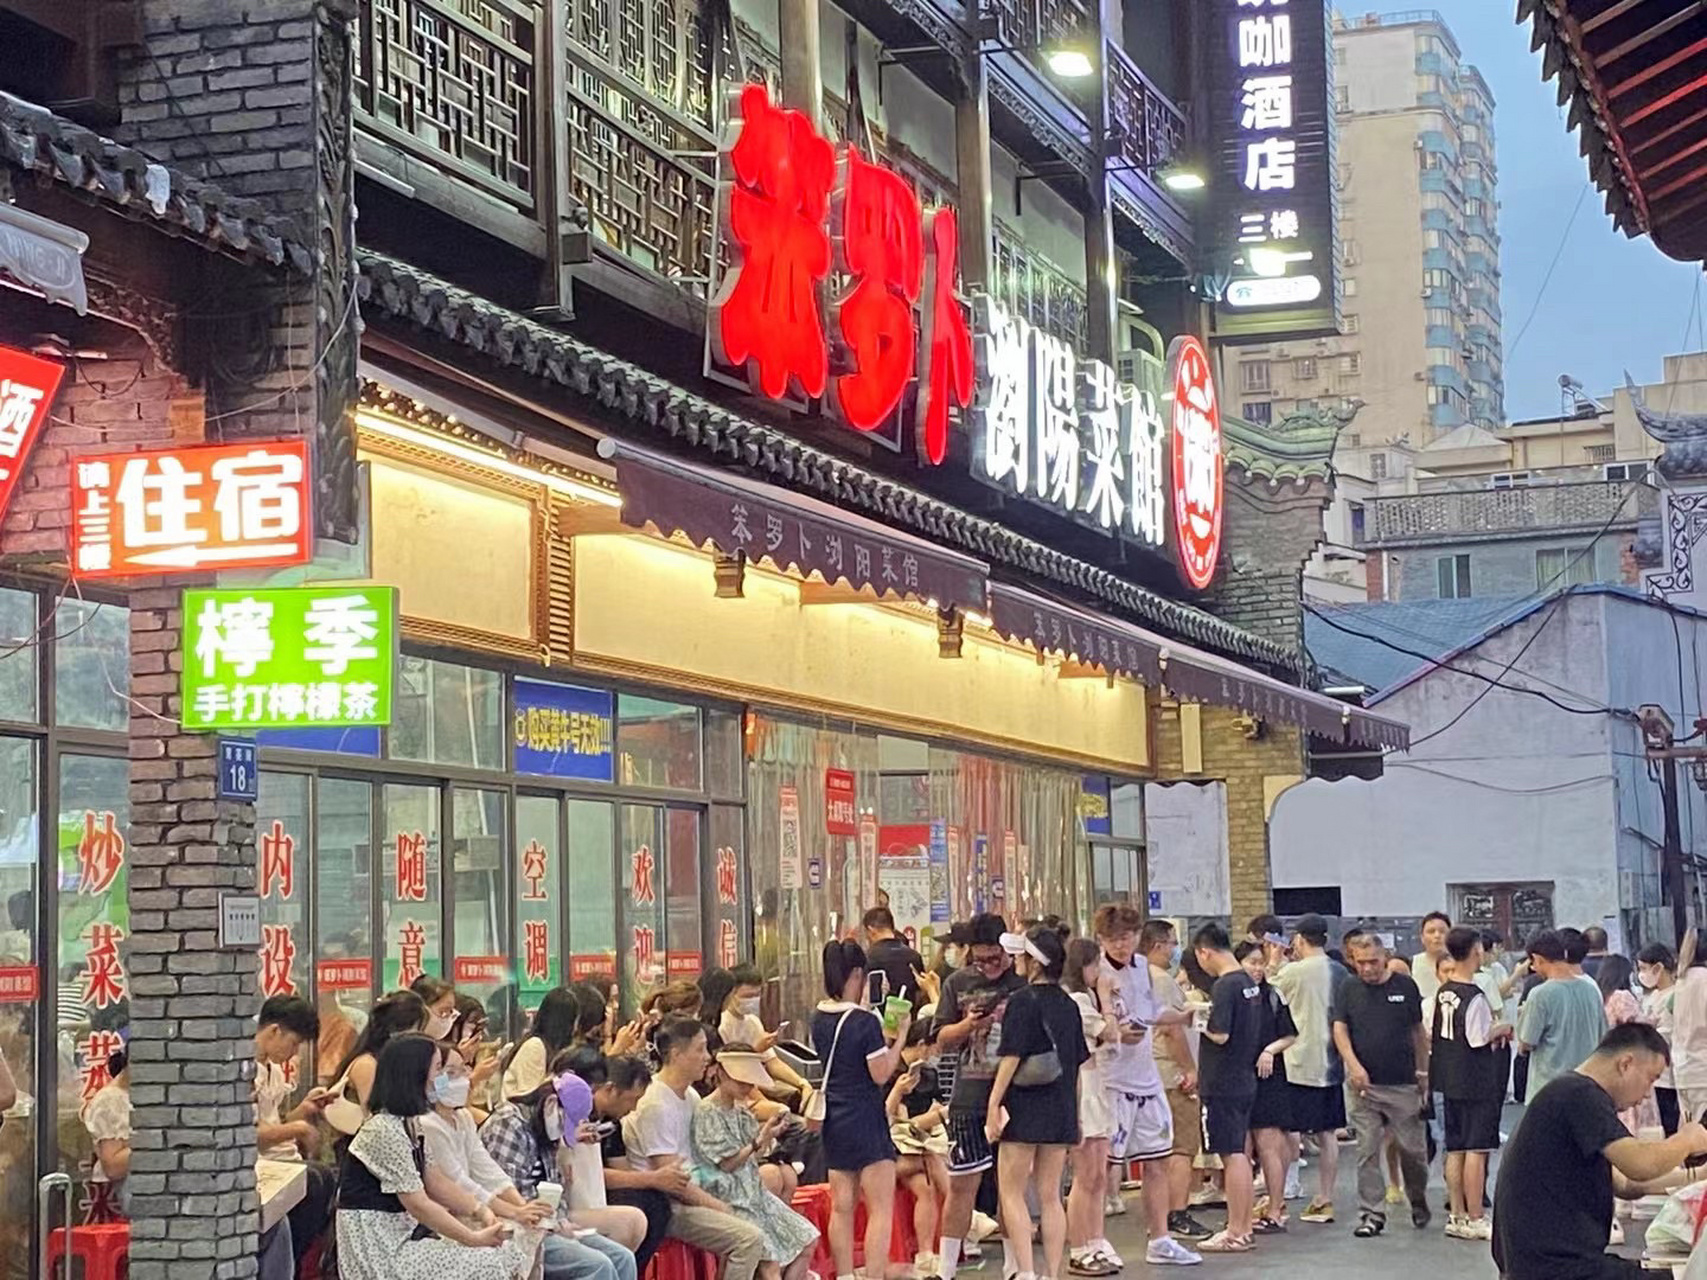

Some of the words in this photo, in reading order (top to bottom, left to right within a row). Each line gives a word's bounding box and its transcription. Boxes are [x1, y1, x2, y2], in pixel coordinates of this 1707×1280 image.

[1236, 0, 1297, 191] 咖酒店
[1238, 209, 1299, 243] 三楼
[116, 451, 303, 548] 住宿
[730, 503, 920, 587] 笨罗卜浏阳菜馆
[230, 764, 246, 792] 18
[394, 829, 427, 988] 随意
[521, 837, 551, 985] 空调
[630, 844, 656, 984] 欢迎
